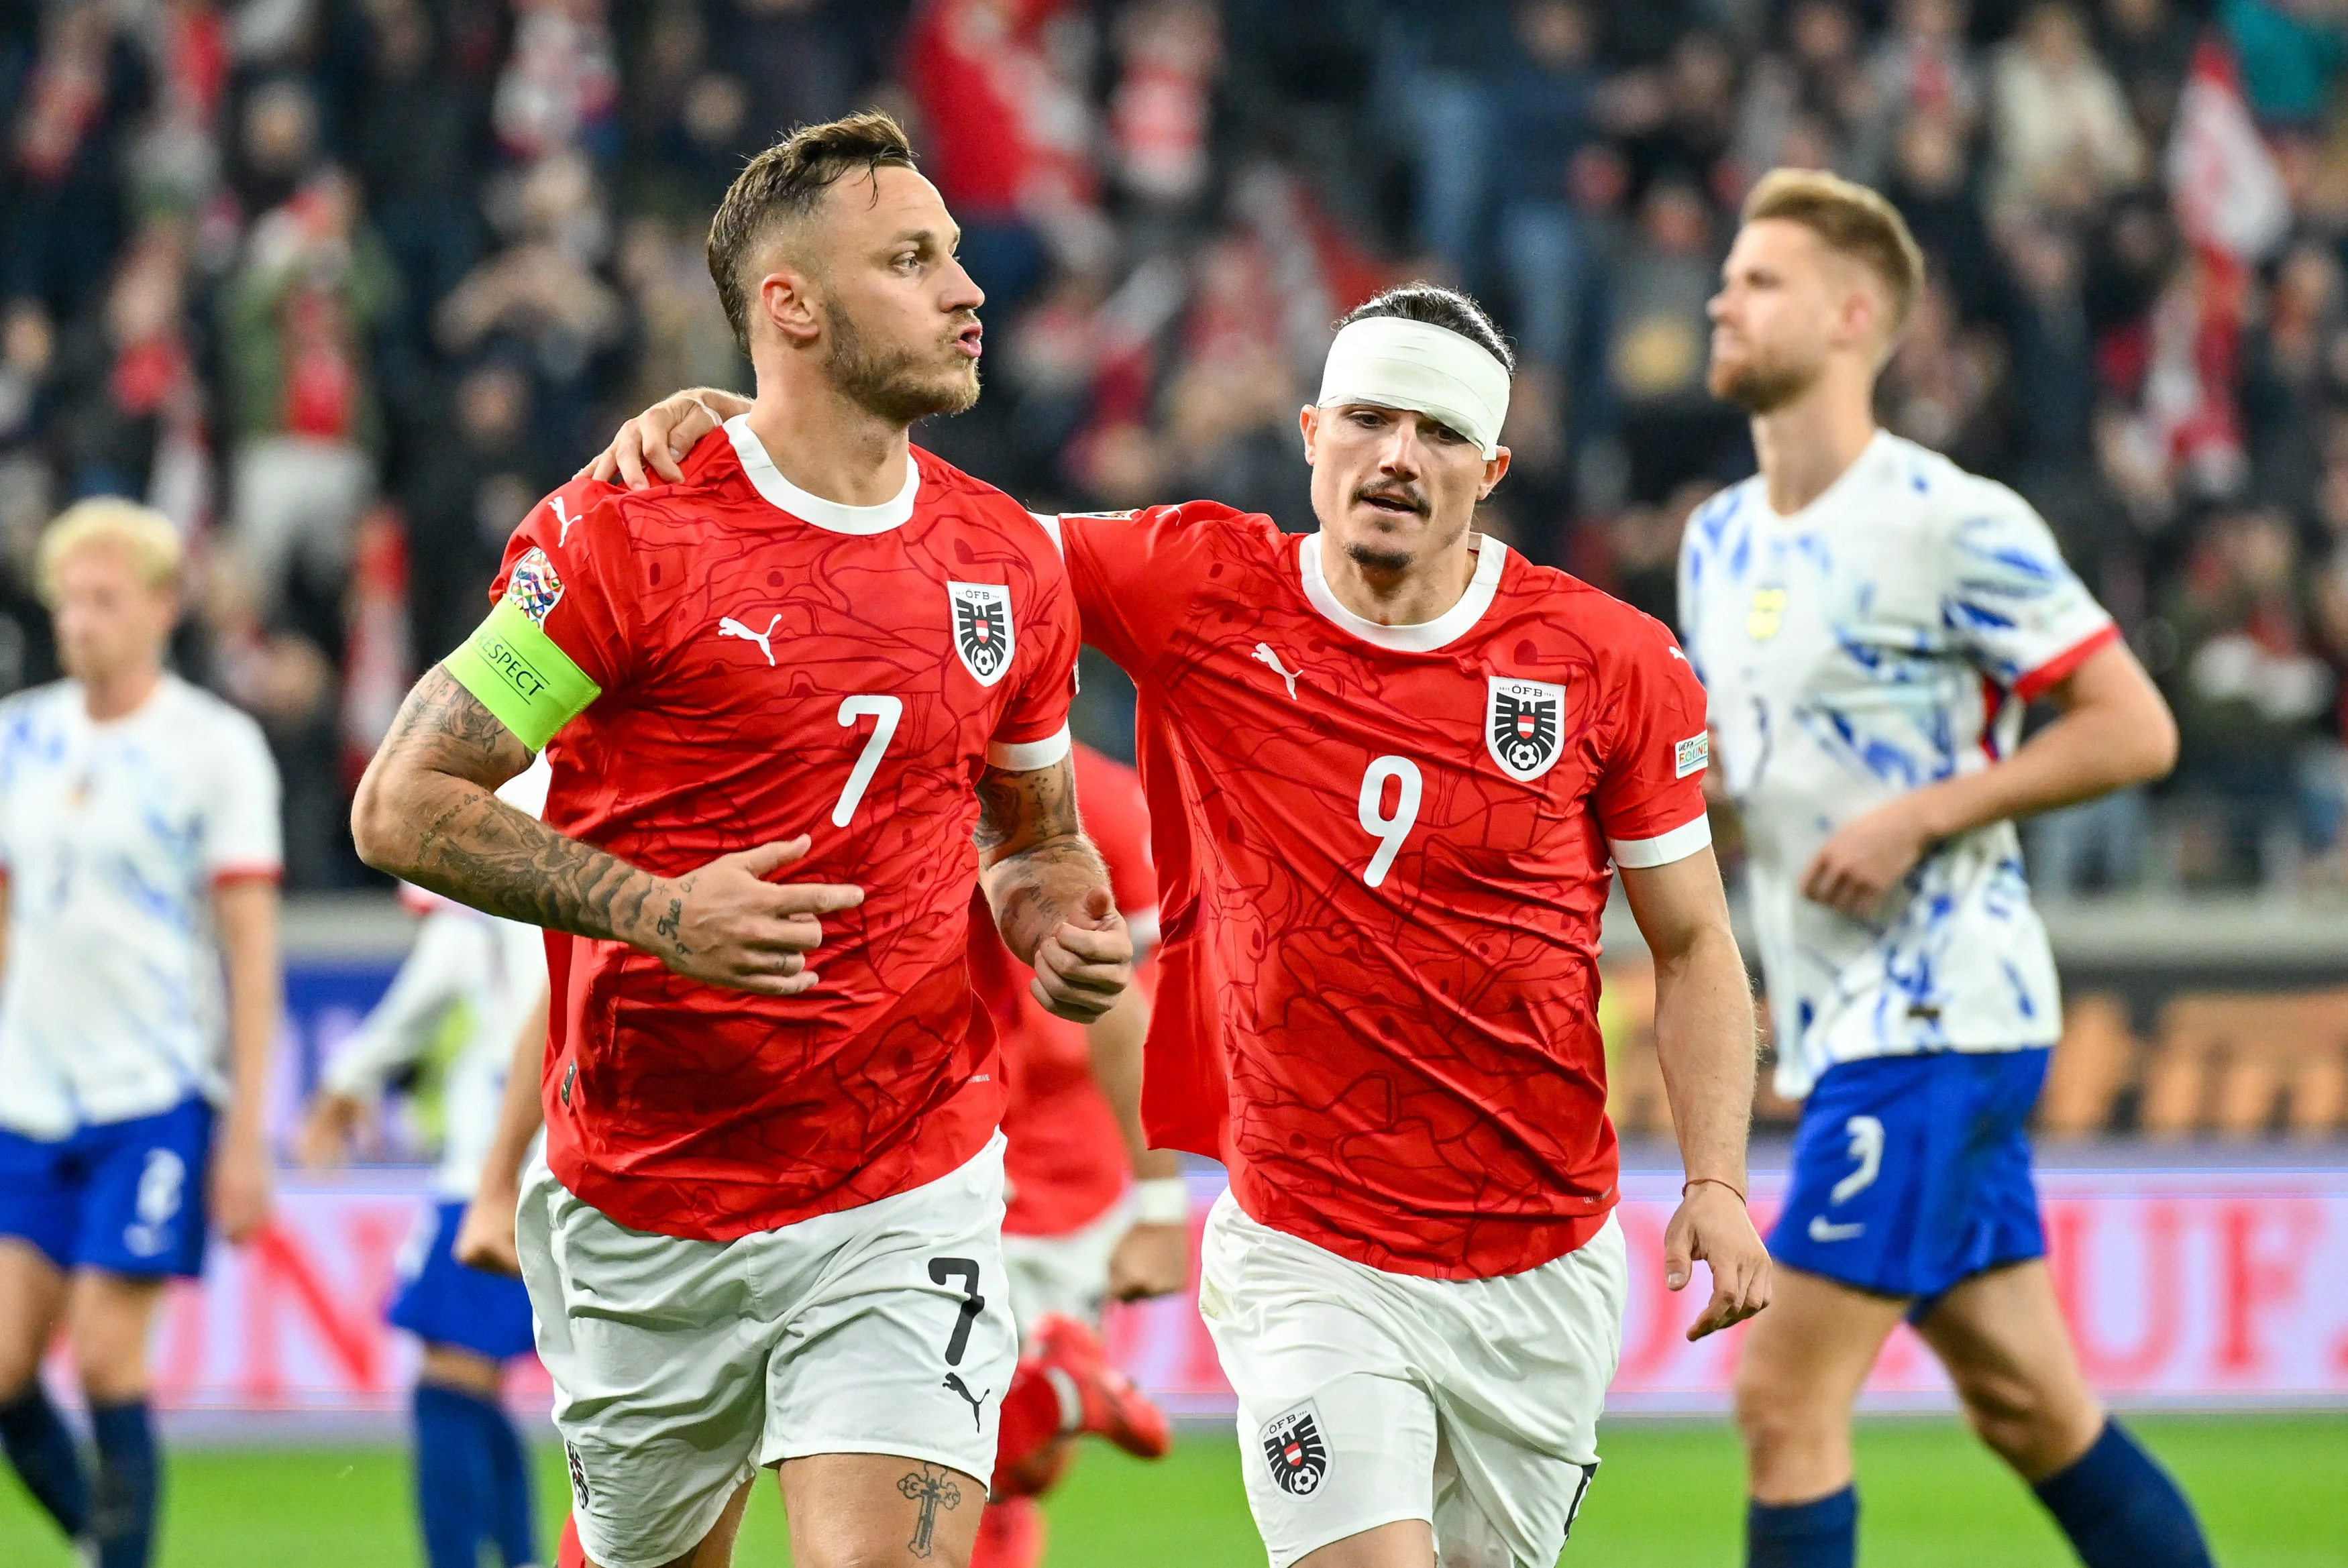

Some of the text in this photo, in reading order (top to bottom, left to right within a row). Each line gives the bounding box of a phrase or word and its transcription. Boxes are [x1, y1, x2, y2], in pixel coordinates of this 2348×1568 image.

[965, 589, 990, 600] ÖFB
[476, 630, 545, 696] RESPECT
[1511, 684, 1542, 697] ÖFB
[831, 695, 903, 828] 7
[1678, 740, 1694, 752] UEFA
[1358, 755, 1423, 887] 9
[1829, 1115, 1886, 1207] 3
[928, 1257, 985, 1366] 7
[1269, 1414, 1296, 1435] ÖFB
